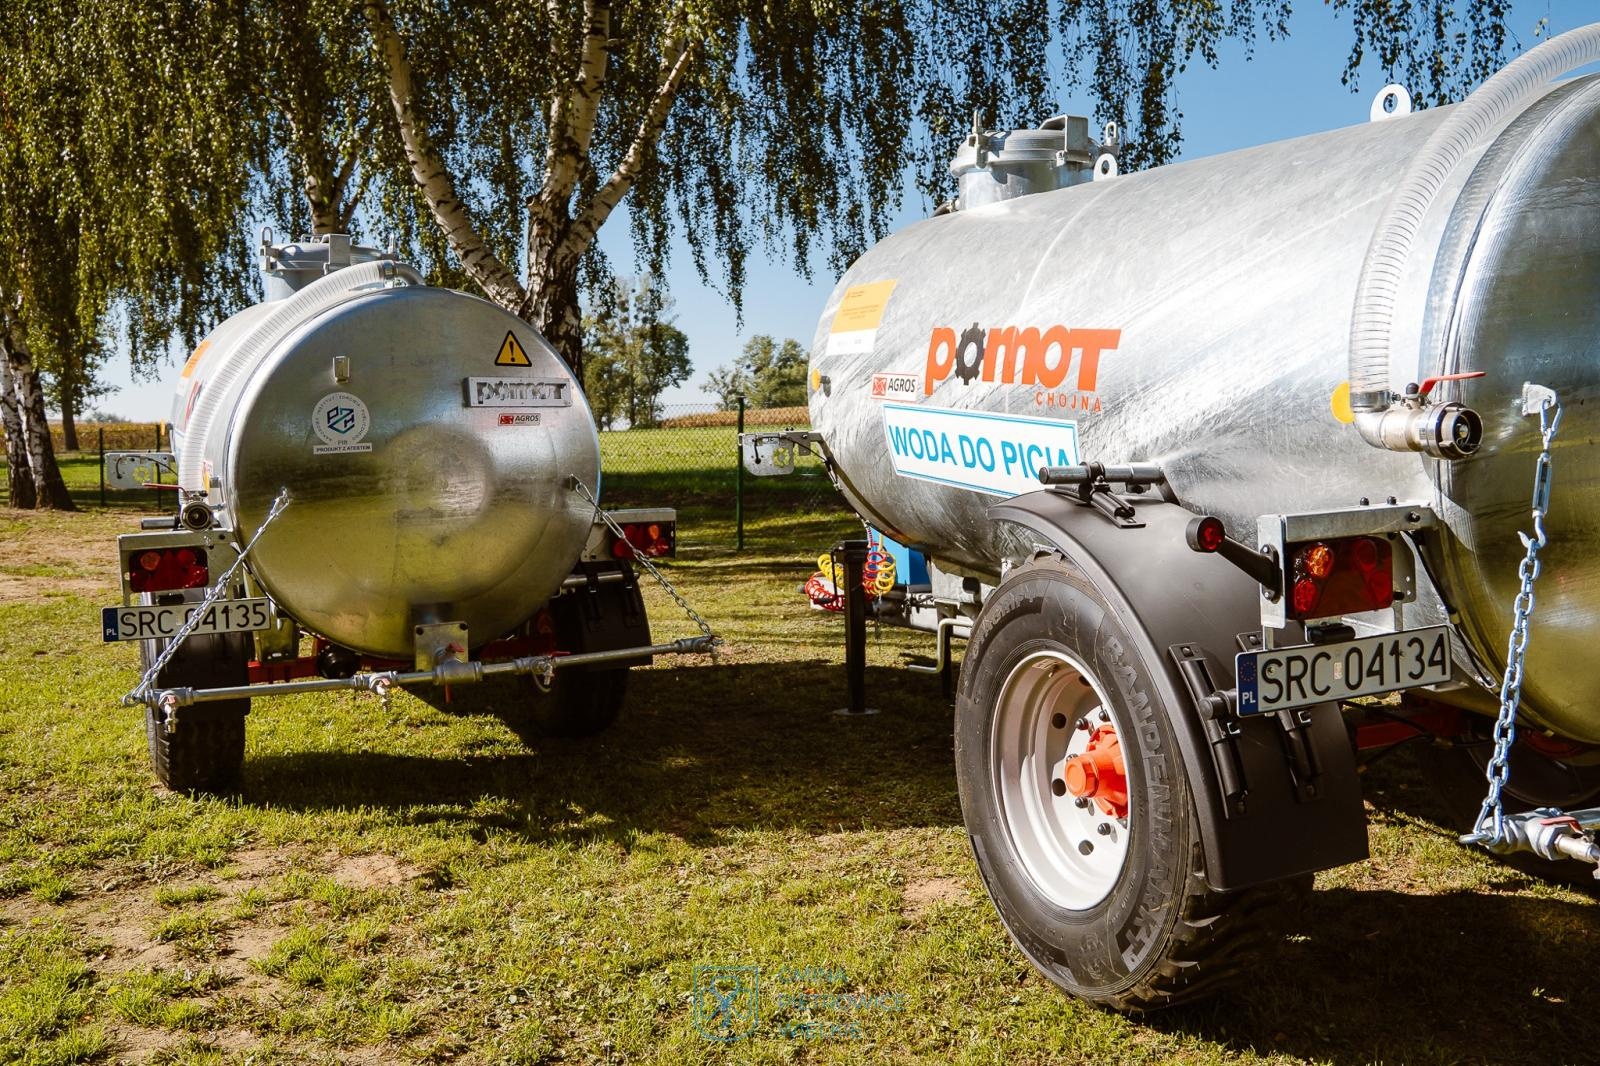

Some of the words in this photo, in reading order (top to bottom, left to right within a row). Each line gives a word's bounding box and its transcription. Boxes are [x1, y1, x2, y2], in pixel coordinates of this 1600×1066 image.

[888, 378, 916, 393] AGROS
[1036, 392, 1102, 412] CHOJNA
[888, 423, 958, 467] WODA
[958, 434, 996, 472] DO
[1001, 440, 1070, 481] PICIA
[106, 628, 118, 636] PL
[120, 610, 174, 637] SRC
[184, 602, 266, 632] 04135
[1242, 692, 1256, 704] PL
[1261, 652, 1332, 704] SRC
[1344, 633, 1447, 691] 04134
